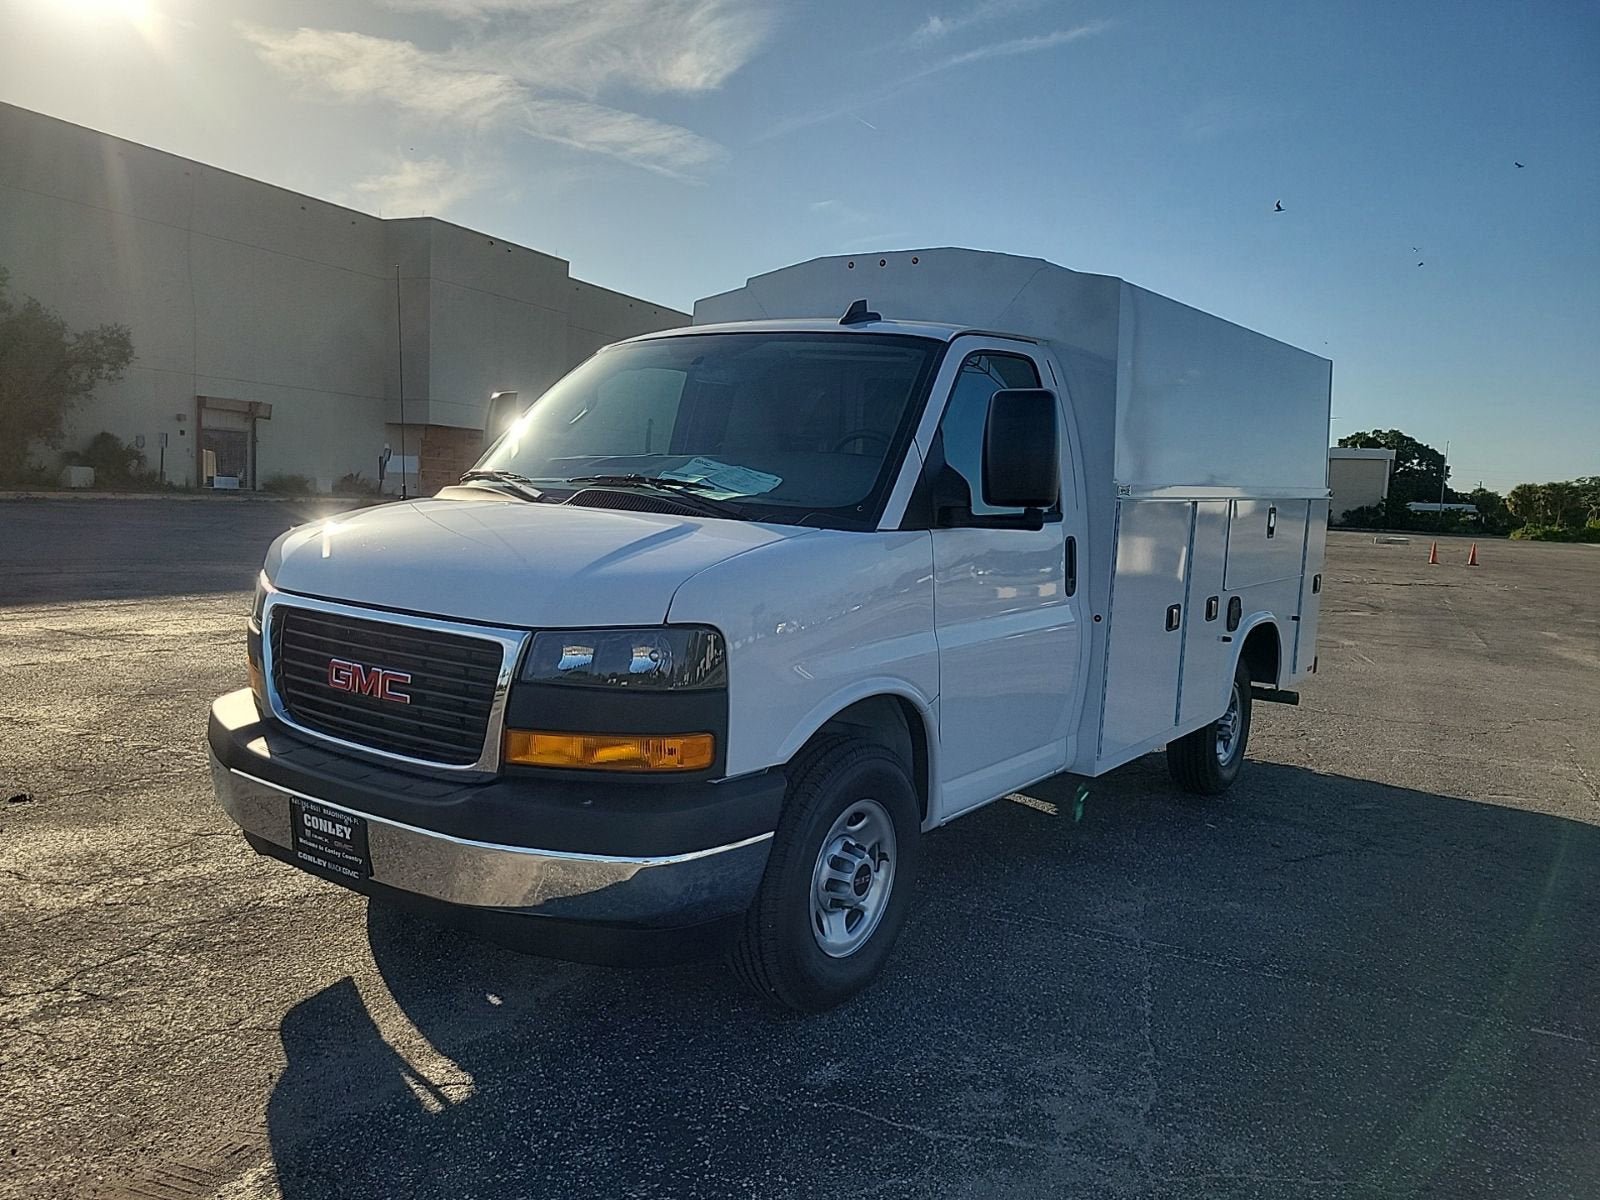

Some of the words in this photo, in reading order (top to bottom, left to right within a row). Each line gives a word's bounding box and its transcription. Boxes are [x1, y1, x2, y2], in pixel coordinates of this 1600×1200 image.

[328, 658, 411, 704] GMC
[303, 813, 352, 840] CONLEY
[297, 851, 327, 868] CONLEY
[342, 867, 360, 879] GMC
[324, 846, 341, 858] Conley
[341, 853, 363, 865] Country
